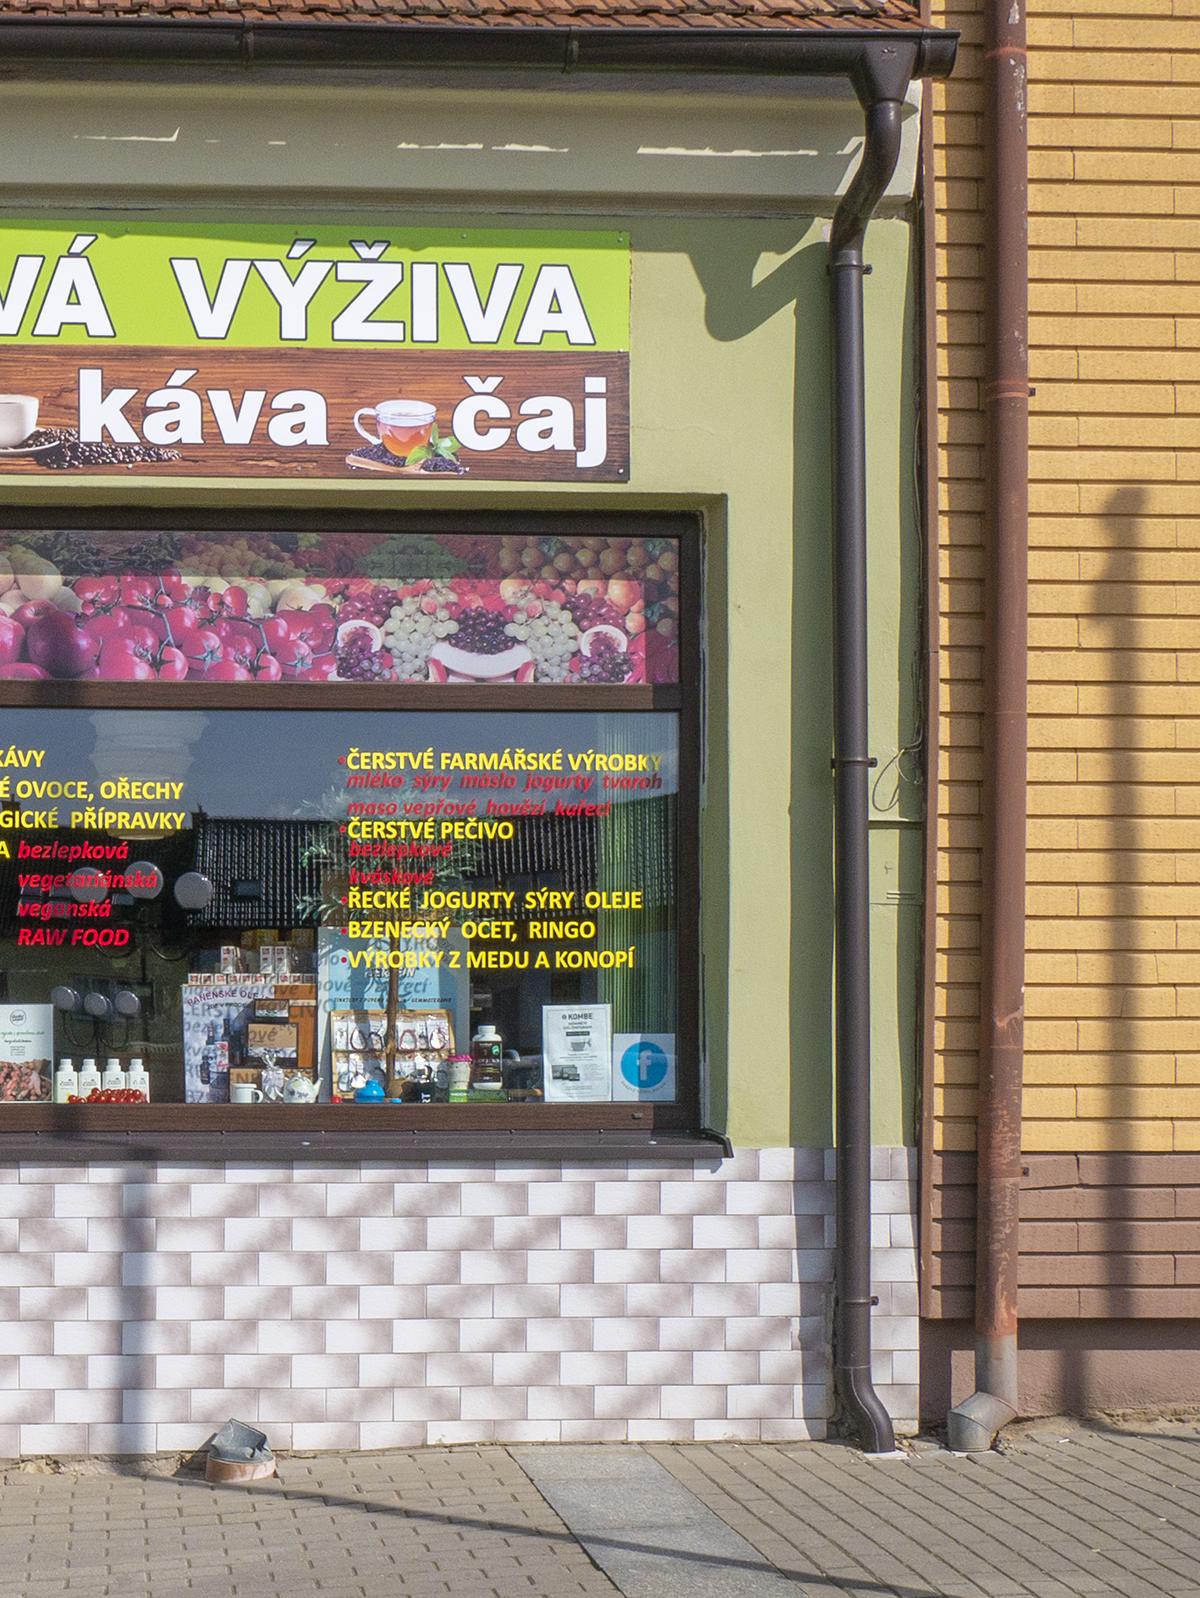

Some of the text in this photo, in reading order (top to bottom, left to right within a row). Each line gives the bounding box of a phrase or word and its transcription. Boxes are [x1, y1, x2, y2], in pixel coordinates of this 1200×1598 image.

[171, 244, 595, 344] VÝŽIVA
[79, 368, 329, 451] káva
[451, 376, 607, 470] čaj
[346, 747, 663, 773] ČERSTVÉ FARMÁŘSKÉ VÝROBKY
[15, 780, 94, 802] OVOCE,
[100, 777, 184, 801] OŘECHY
[347, 770, 663, 792] mléko sýry máslo jogurty tvaroh
[70, 806, 186, 831] PŘÍPRAVKY
[347, 798, 611, 818] maso vepřové hovězí kuřecí
[347, 816, 516, 841] ČERSTVÉ PEČIVO
[16, 839, 130, 863] bezlepková
[348, 840, 452, 859] bezlepkové
[17, 869, 159, 893] vegetariánská
[348, 866, 434, 886] kváskové
[17, 897, 113, 922] veganská
[347, 885, 644, 912] ŘECKÉ JOGURTY SÝRY OLEJE
[15, 927, 131, 948] RAW FOOD
[347, 915, 597, 943] BZENECKÝ OCET, RINGO
[348, 945, 636, 970] VÝROBKY Z MEDU A KONOPÍ
[187, 988, 237, 1006] PANENSKÉ
